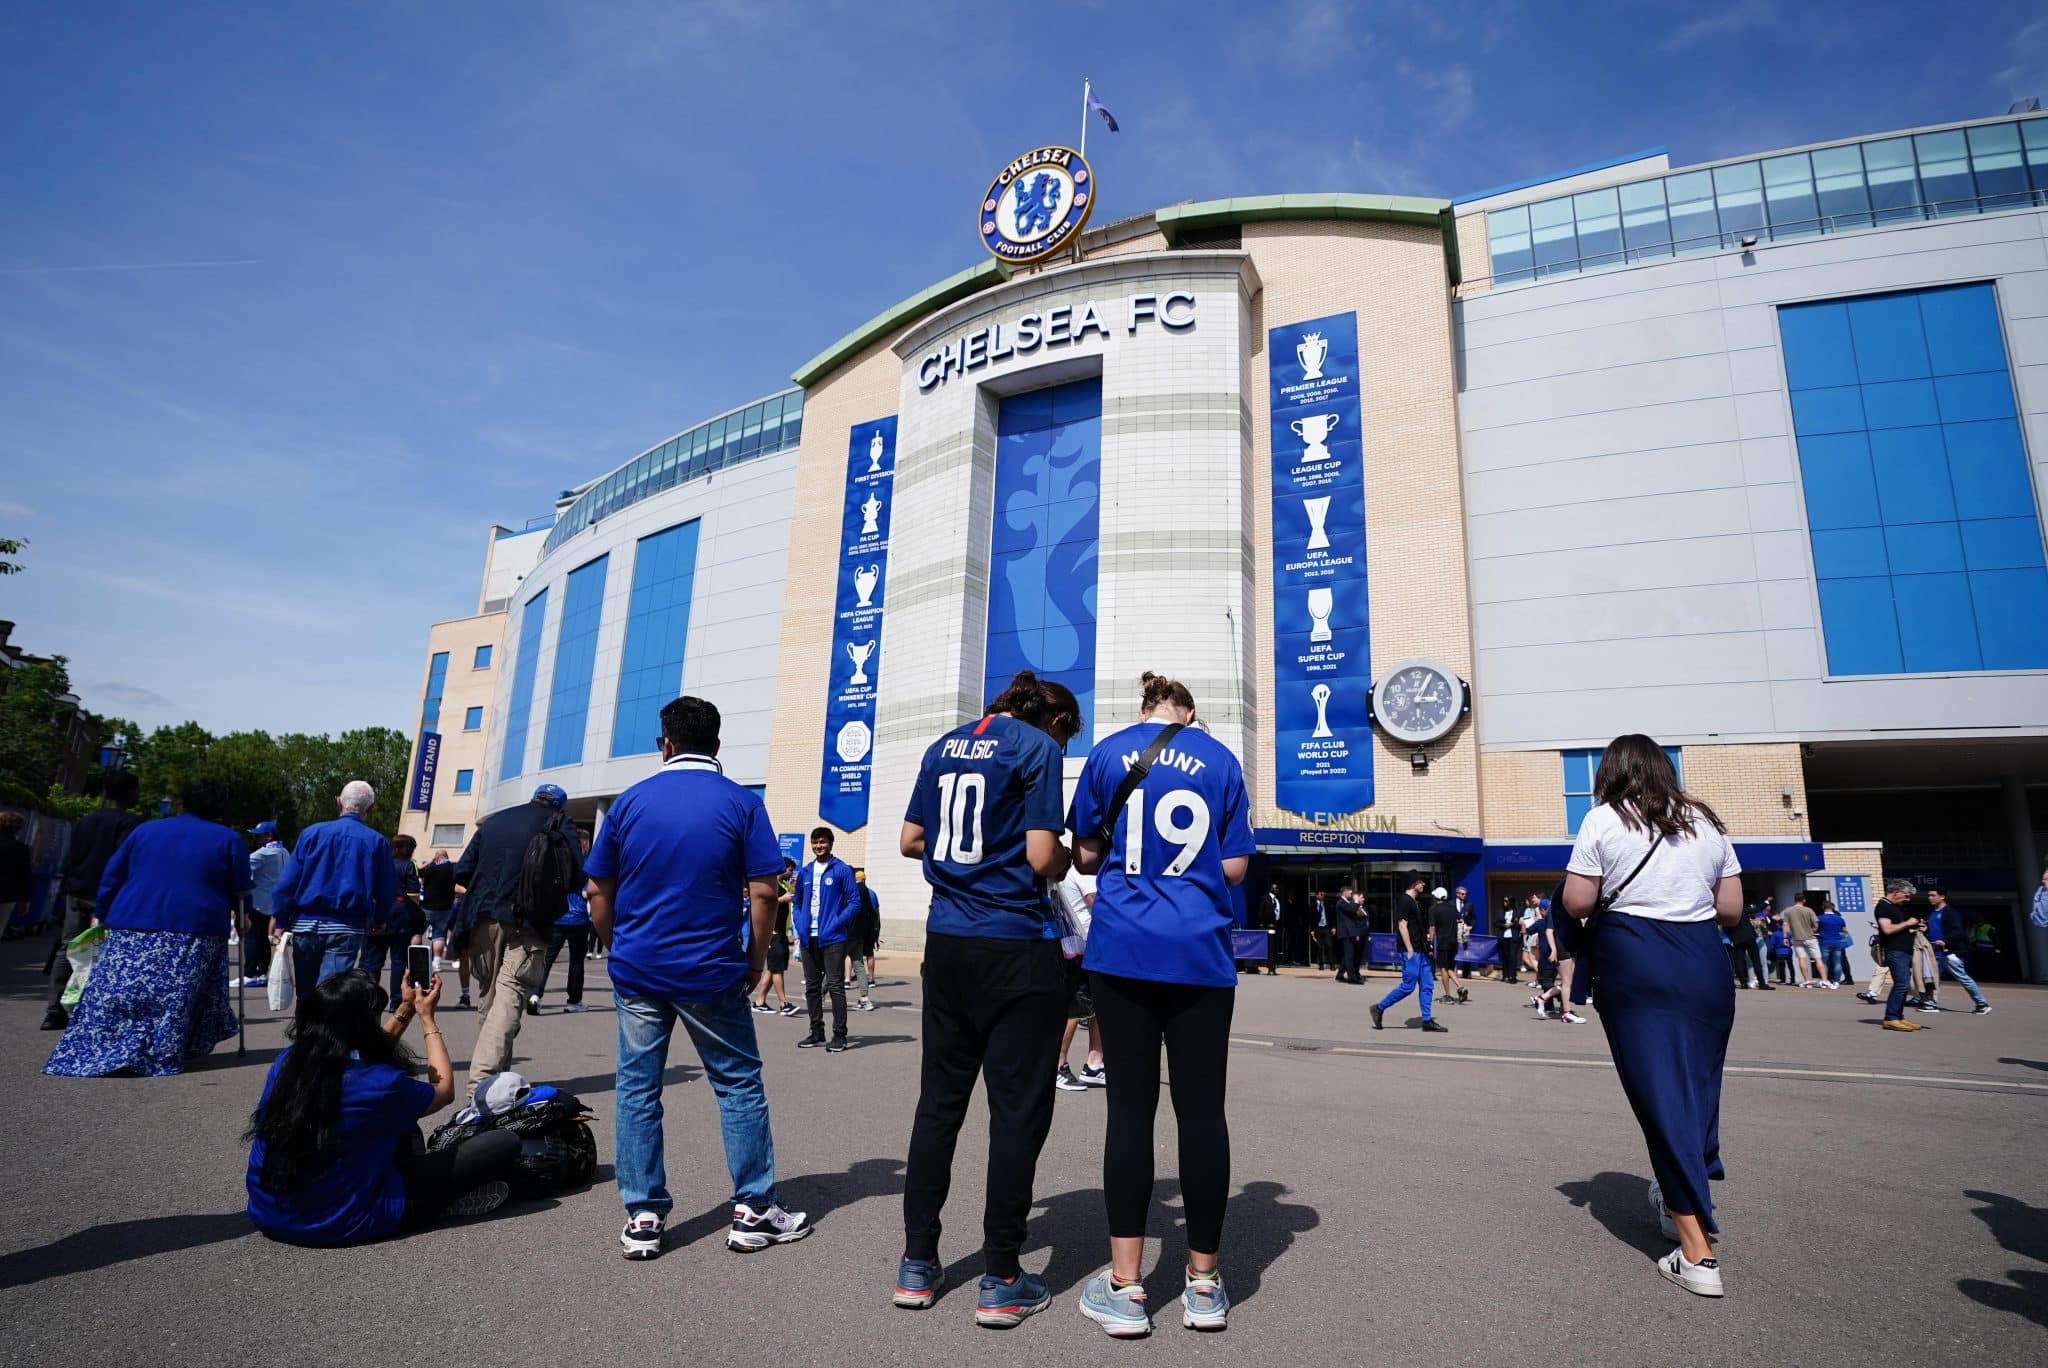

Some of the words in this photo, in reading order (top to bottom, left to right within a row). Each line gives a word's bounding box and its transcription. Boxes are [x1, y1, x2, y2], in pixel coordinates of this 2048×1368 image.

[999, 149, 1071, 184] CHELSEA
[996, 241, 1043, 254] FOOTBALL
[1047, 220, 1071, 243] CLUB
[917, 300, 1110, 389] CHELSEA
[1127, 290, 1196, 332] FC
[1280, 382, 1315, 394] PREMIER
[1317, 376, 1348, 387] LEAGUE
[1292, 464, 1322, 474] LEAGUE
[1324, 461, 1342, 470] CUP
[1286, 561, 1318, 571] EUROPA
[1320, 557, 1353, 567] LEAGUE
[1306, 552, 1328, 560] UEFA
[1298, 654, 1325, 663] SUPER
[1327, 652, 1345, 660] CUP
[1310, 644, 1332, 652] UEFA
[424, 738, 437, 772] STAND
[941, 739, 998, 760] PULISIC
[419, 775, 431, 804] WEST
[932, 772, 986, 865] 10
[1261, 810, 1397, 832] MILLENNIUM
[1125, 788, 1210, 876] 19
[1300, 832, 1365, 844] RECEPTION
